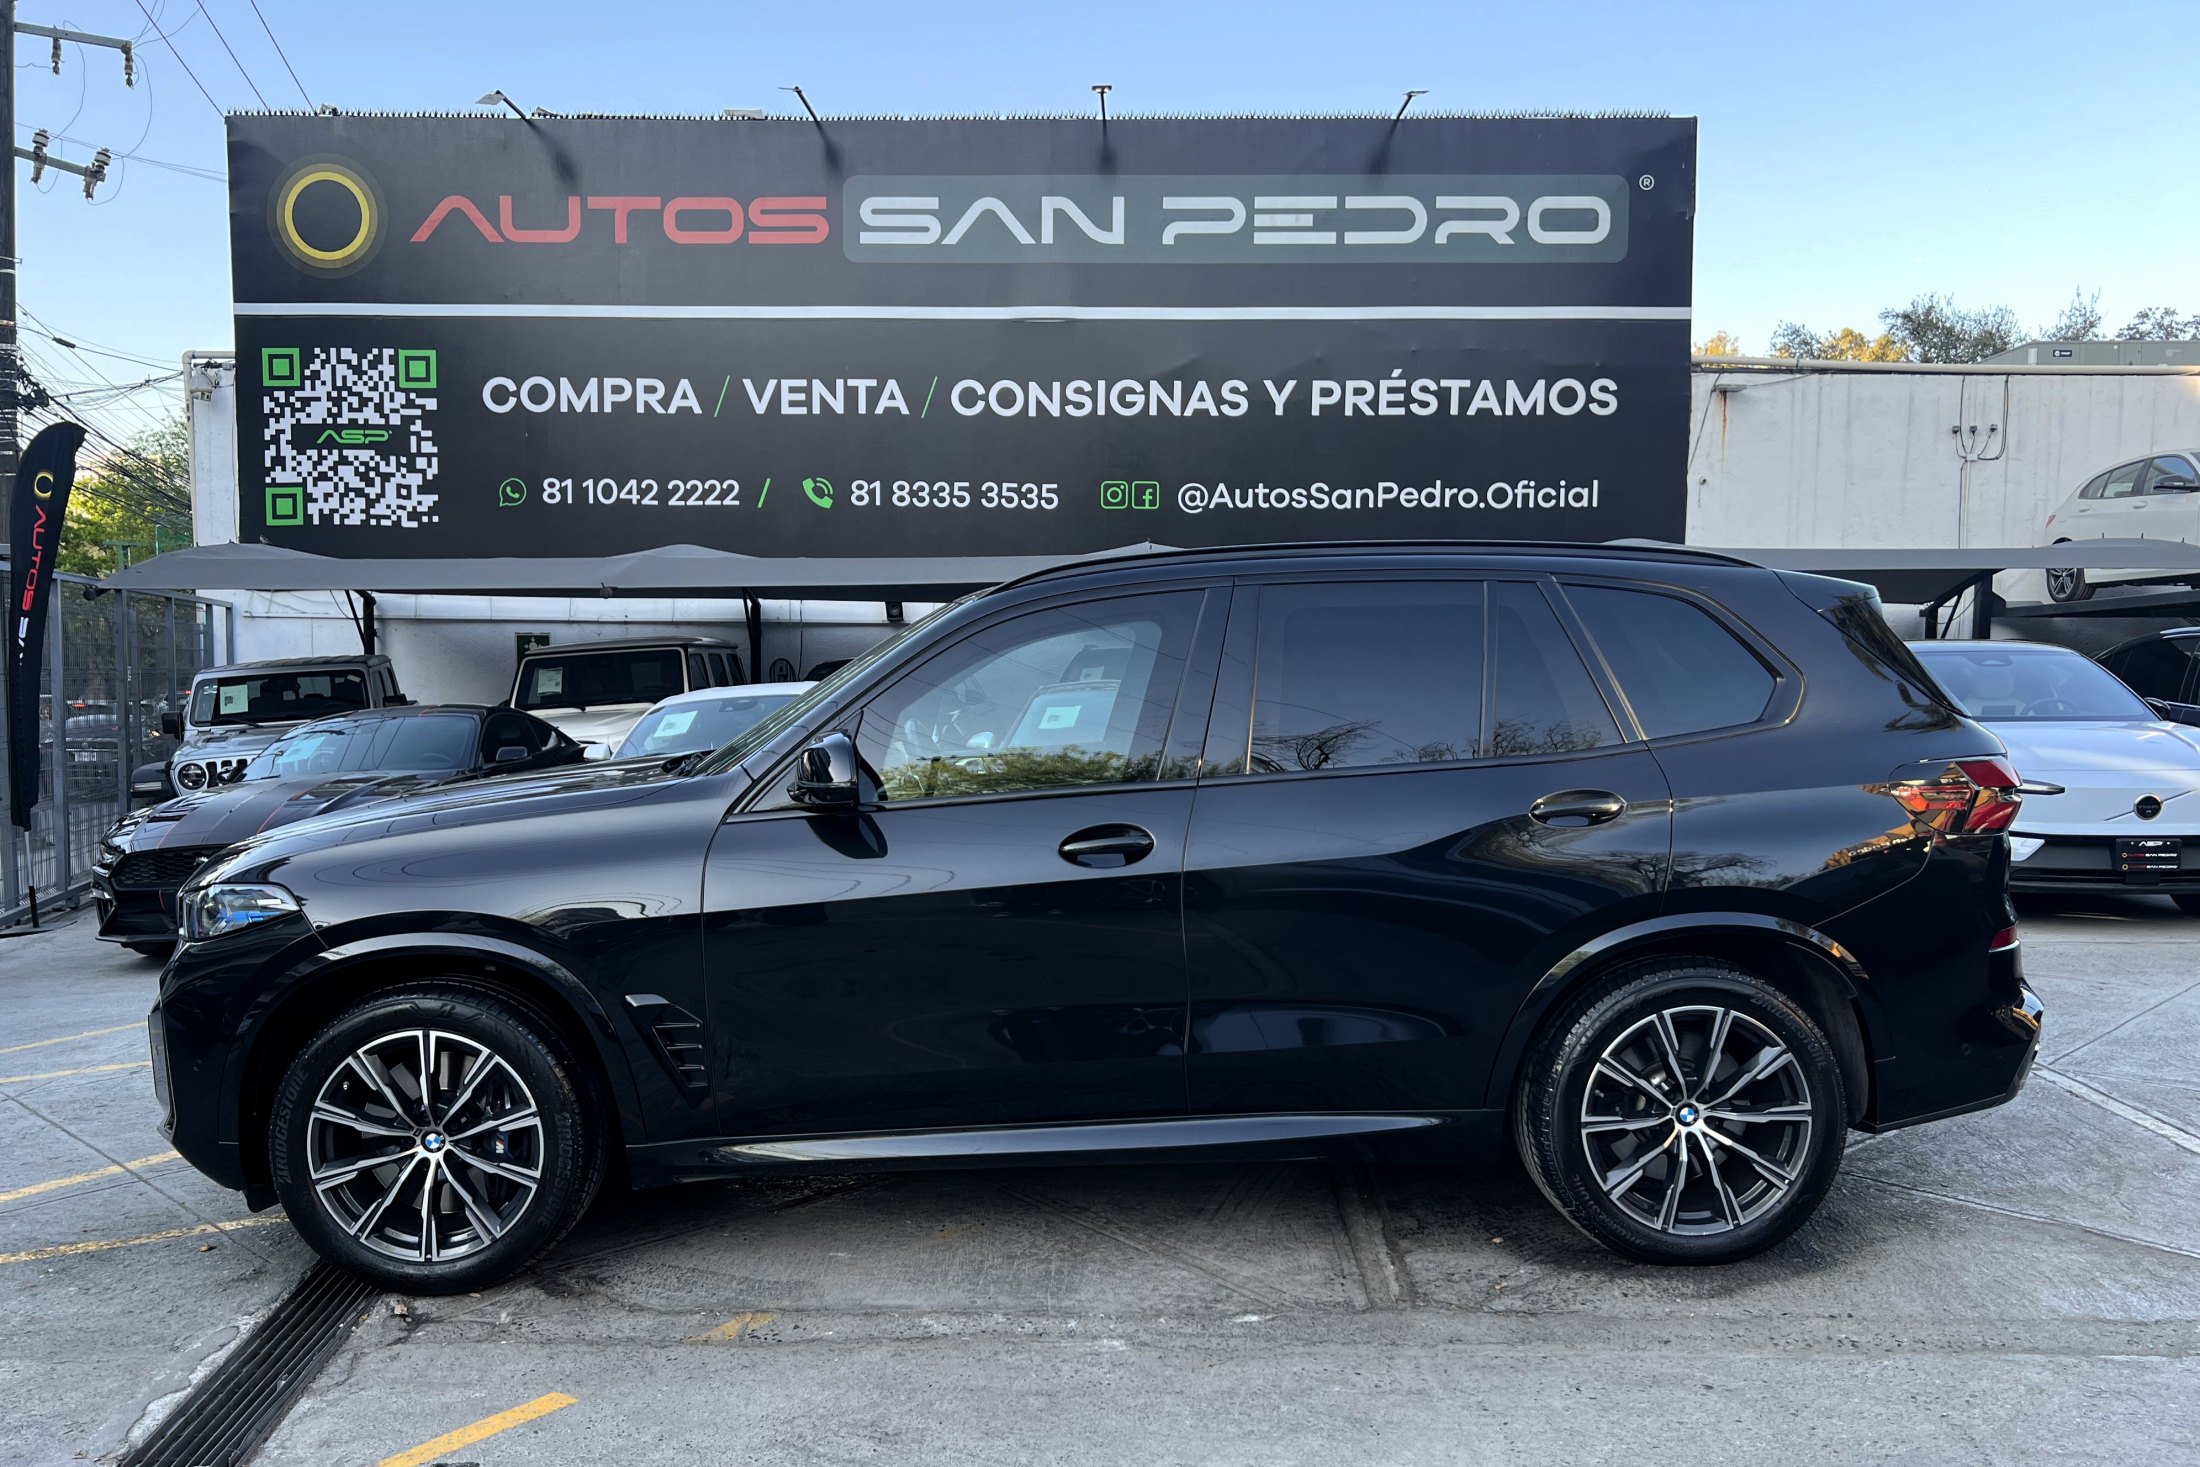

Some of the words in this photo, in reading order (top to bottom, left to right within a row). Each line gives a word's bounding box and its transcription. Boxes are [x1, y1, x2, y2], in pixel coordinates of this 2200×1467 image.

[410, 195, 830, 244] AUTOS
[858, 194, 1126, 246] SAN
[1161, 194, 1612, 246] PEDRO
[481, 375, 703, 416] COMPRA
[741, 377, 911, 417] VENTA
[950, 378, 1249, 419] CONSIGNAS
[1263, 379, 1299, 417] Y
[1310, 368, 1619, 418] PRÉSTAMOS
[541, 476, 574, 505] 81
[582, 477, 660, 507] 1042
[667, 478, 741, 507] 2222
[850, 478, 881, 507] 81
[891, 480, 972, 510] 8335
[980, 481, 1061, 511] 3535
[1177, 478, 1600, 515] @AutosSanPedro.Oficial
[21, 503, 48, 612] AUTOS
